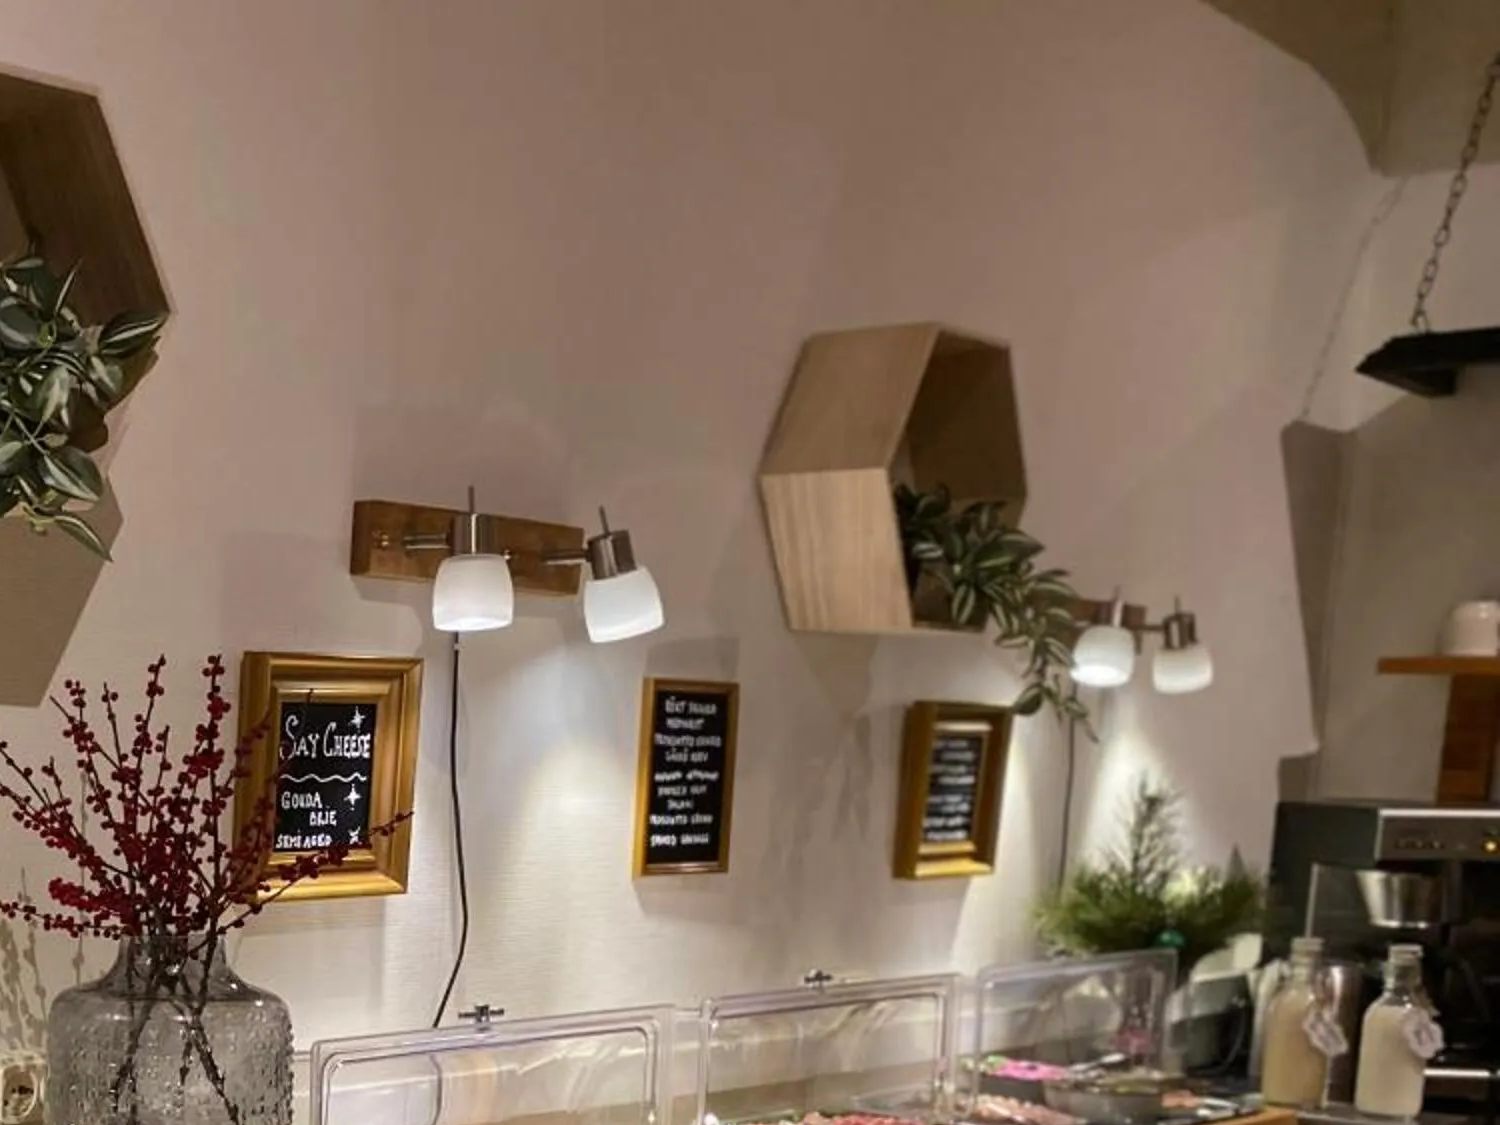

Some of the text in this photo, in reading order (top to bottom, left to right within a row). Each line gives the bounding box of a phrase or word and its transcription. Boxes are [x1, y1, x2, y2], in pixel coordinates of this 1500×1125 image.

[279, 715, 371, 761] SAY CHEESE
[281, 791, 322, 810] GOUDA
[309, 808, 337, 827] BRIE
